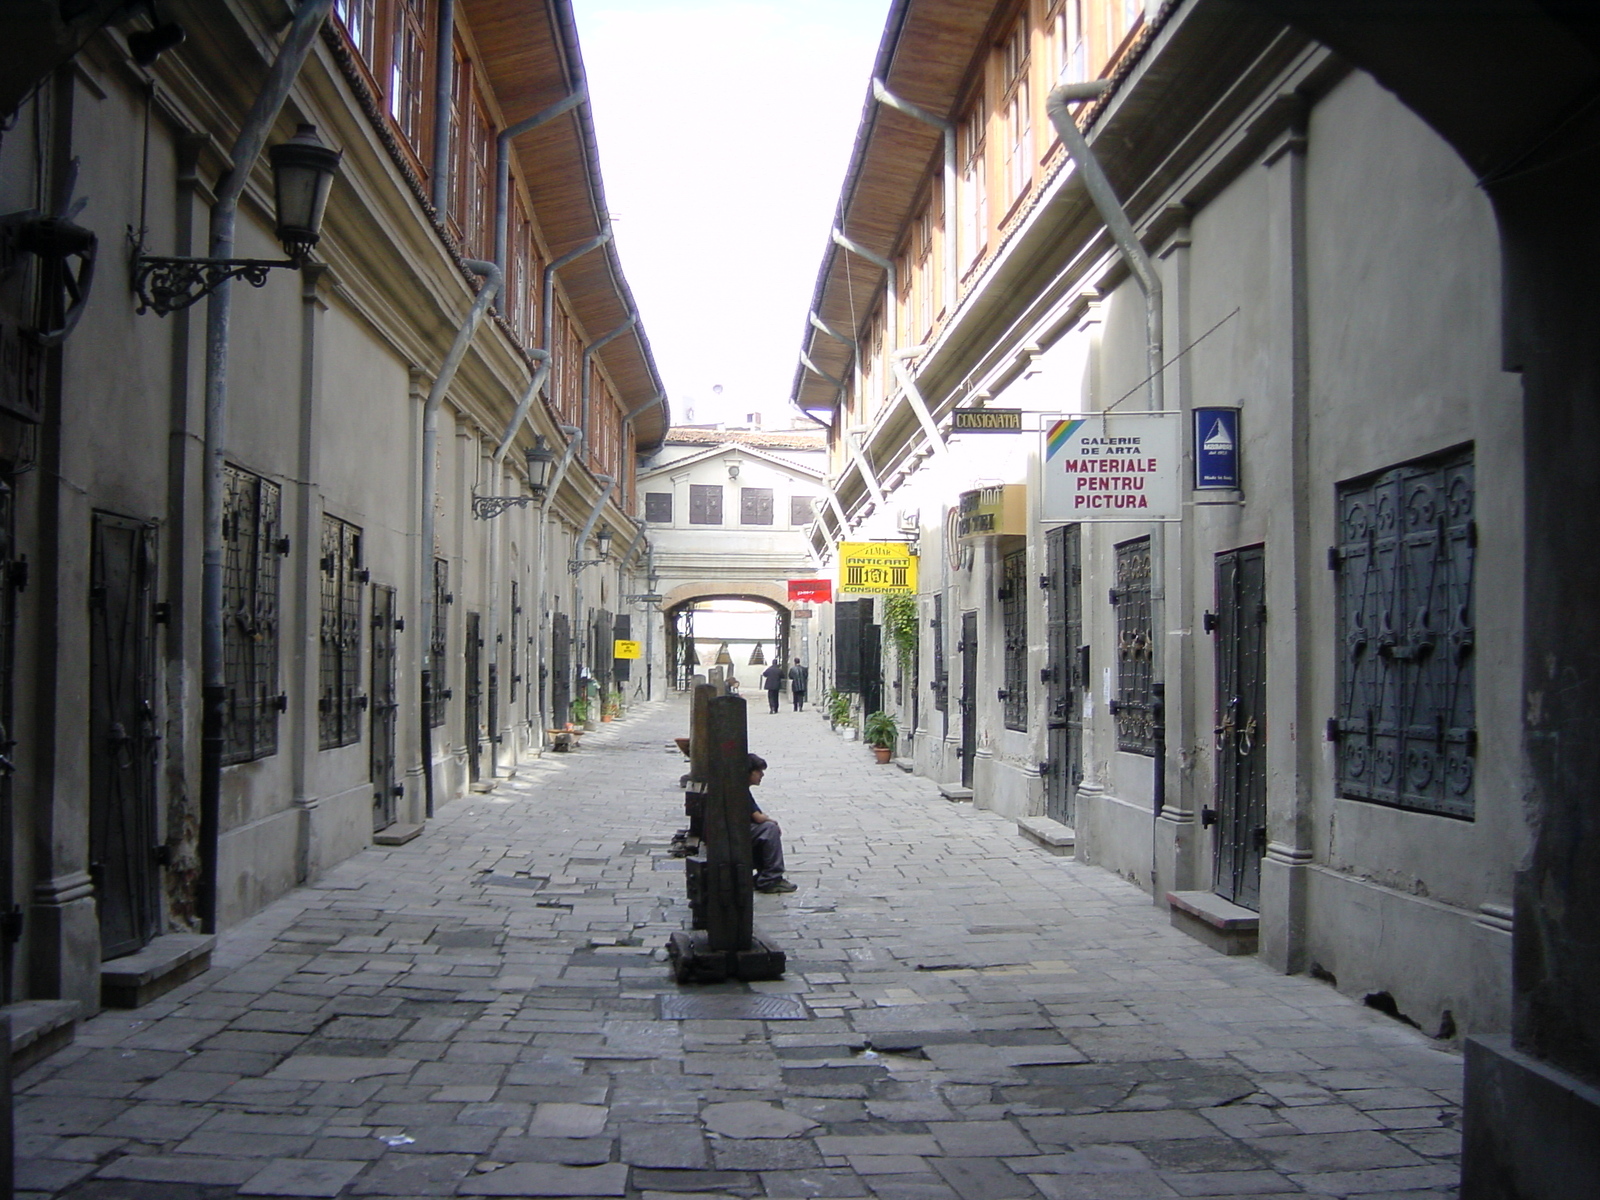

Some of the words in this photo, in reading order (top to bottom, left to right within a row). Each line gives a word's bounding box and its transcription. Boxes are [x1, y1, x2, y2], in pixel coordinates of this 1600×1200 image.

[1081, 437, 1141, 446] GALERIE
[1081, 447, 1099, 455] DE
[1106, 446, 1141, 455] ARTA
[1065, 458, 1157, 473] MATERIALE
[1076, 476, 1144, 491] PENTRU
[1074, 494, 1148, 509] PICTURA
